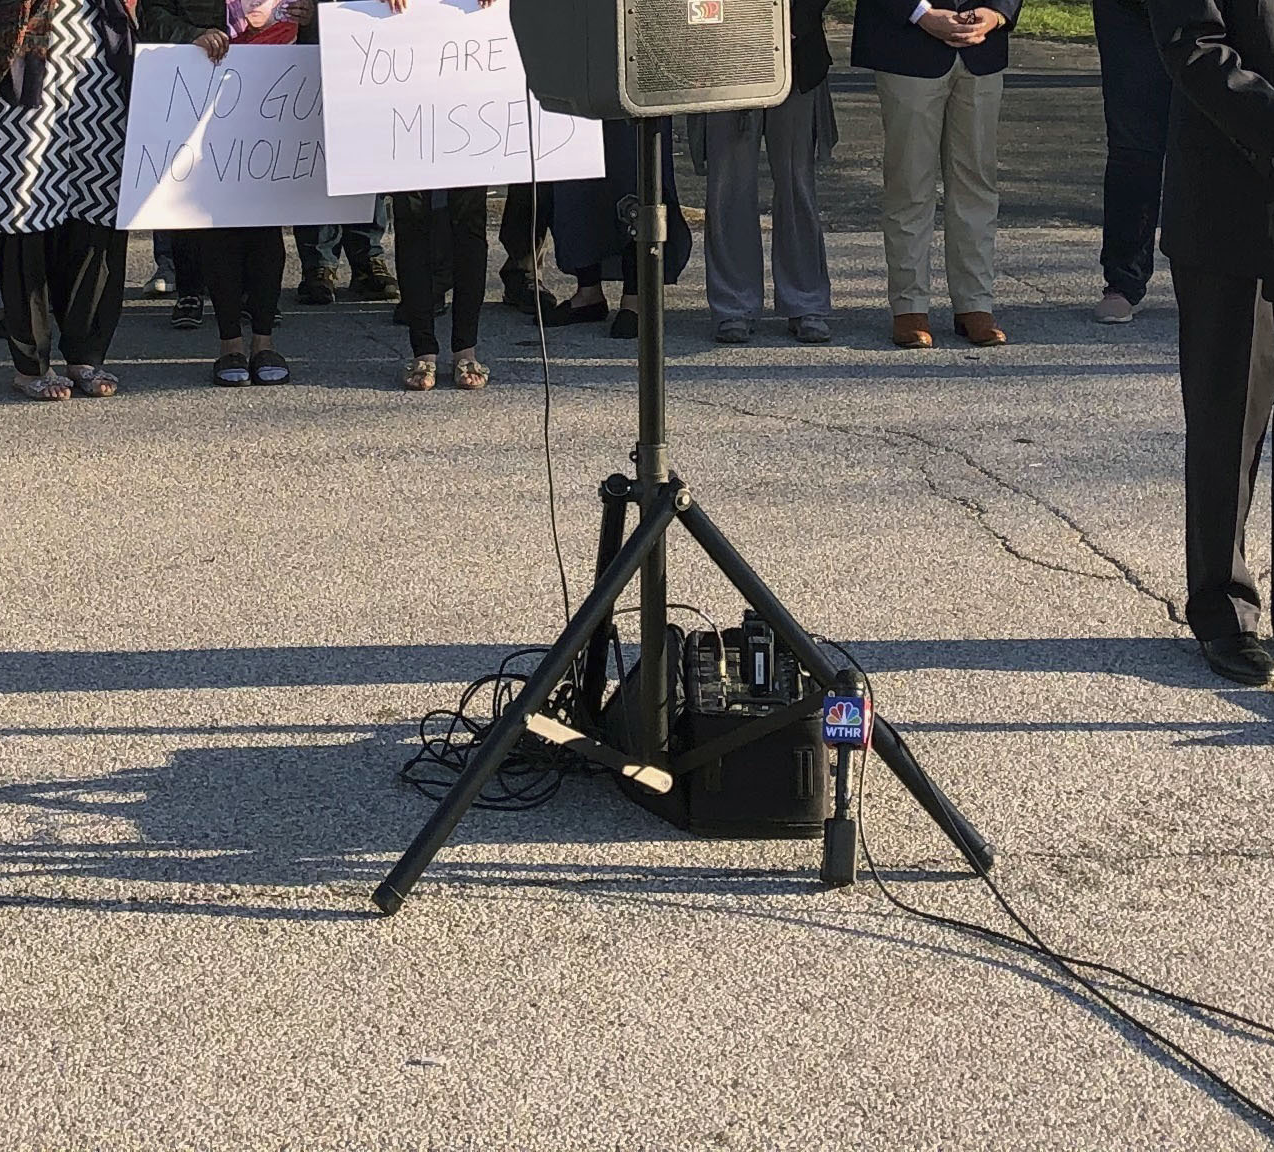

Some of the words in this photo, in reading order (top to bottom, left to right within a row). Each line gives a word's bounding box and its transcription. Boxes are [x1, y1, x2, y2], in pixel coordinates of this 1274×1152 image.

[351, 31, 414, 85] YOU
[439, 37, 508, 77] ARE
[165, 64, 242, 122] NO
[259, 64, 324, 122] GU
[392, 99, 576, 164] MISSED
[135, 140, 195, 189] NO
[826, 726, 861, 737] WTHR
